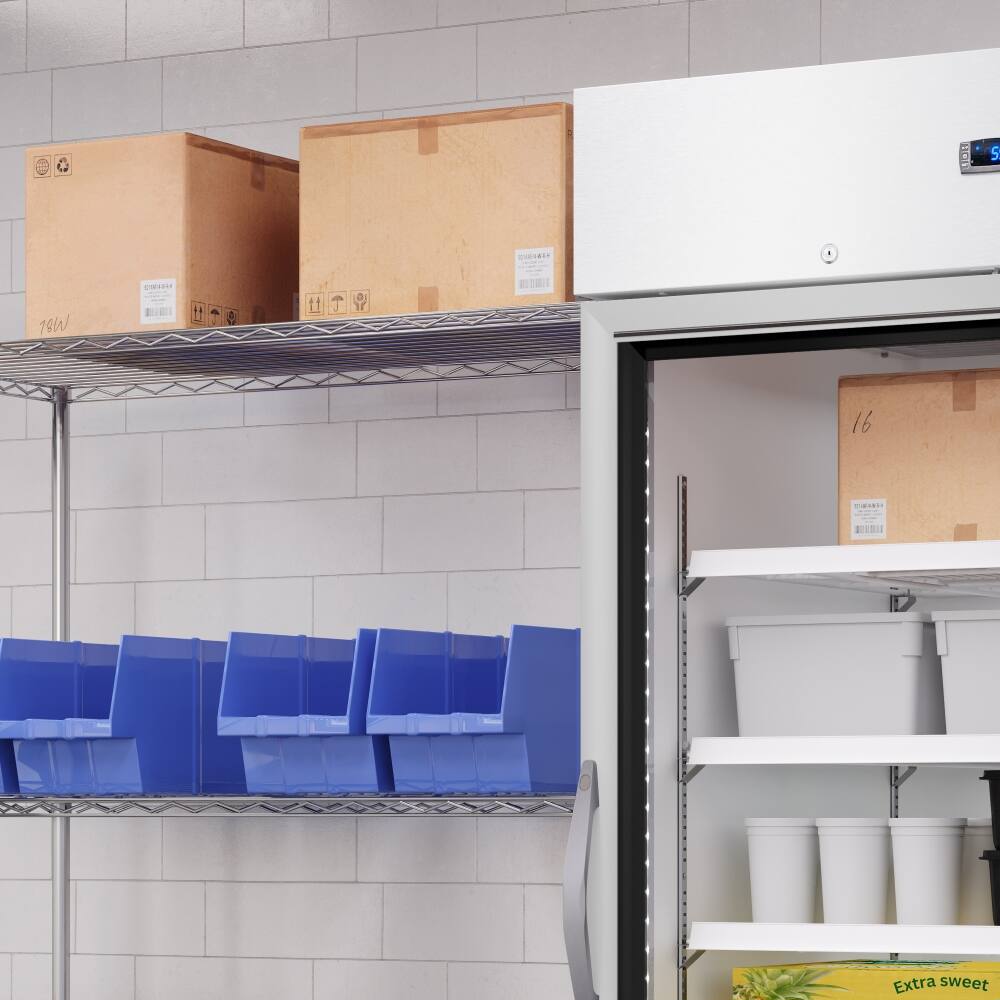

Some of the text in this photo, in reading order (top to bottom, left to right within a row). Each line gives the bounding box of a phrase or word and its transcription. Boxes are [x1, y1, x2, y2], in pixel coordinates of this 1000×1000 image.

[852, 410, 873, 433] 16
[893, 976, 990, 994] Extra sweet
